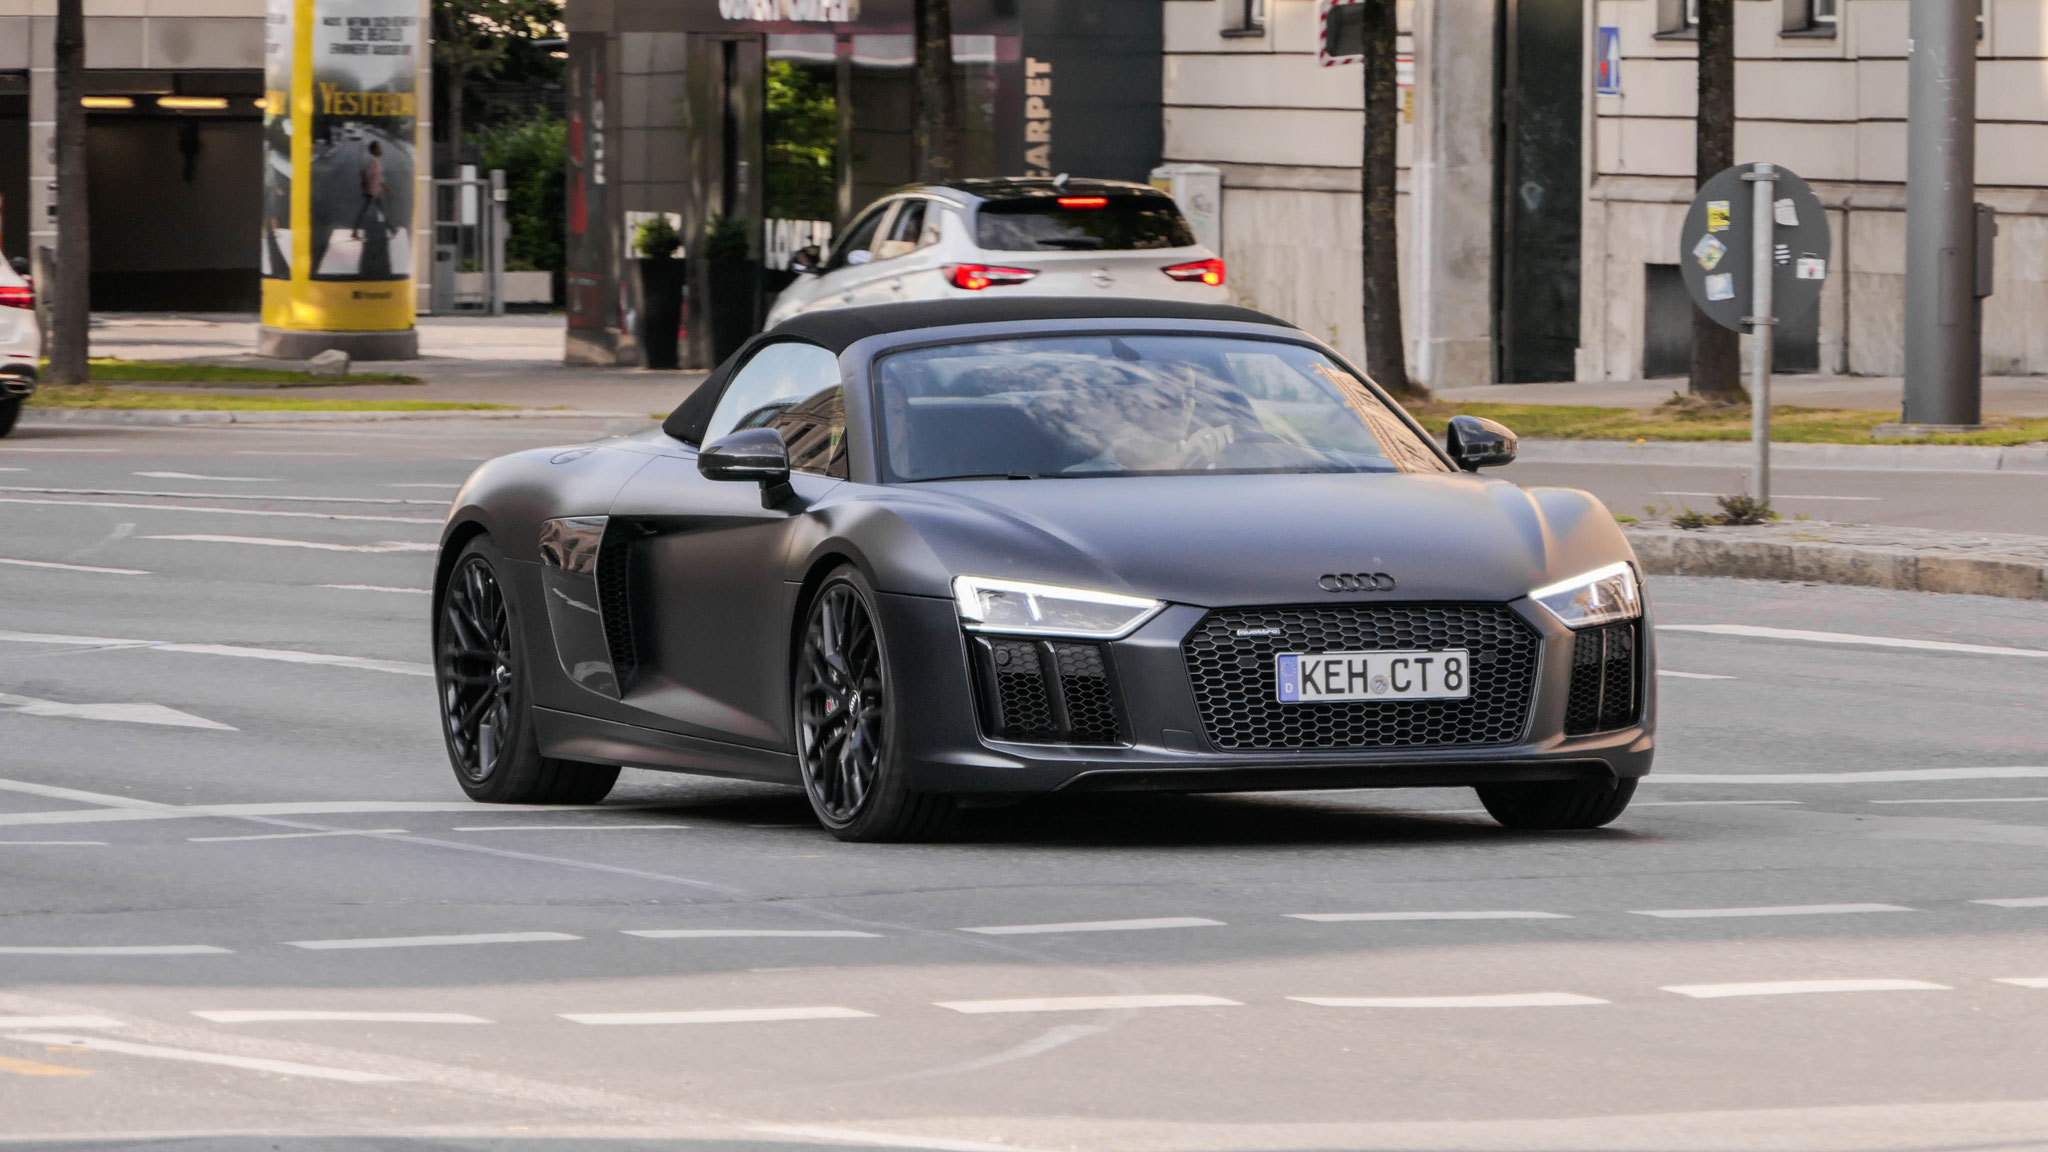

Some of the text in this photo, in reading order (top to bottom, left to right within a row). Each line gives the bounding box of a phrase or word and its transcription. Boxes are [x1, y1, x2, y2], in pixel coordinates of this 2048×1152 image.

[1300, 656, 1463, 695] KEH CT 8
[1284, 683, 1294, 693] D
